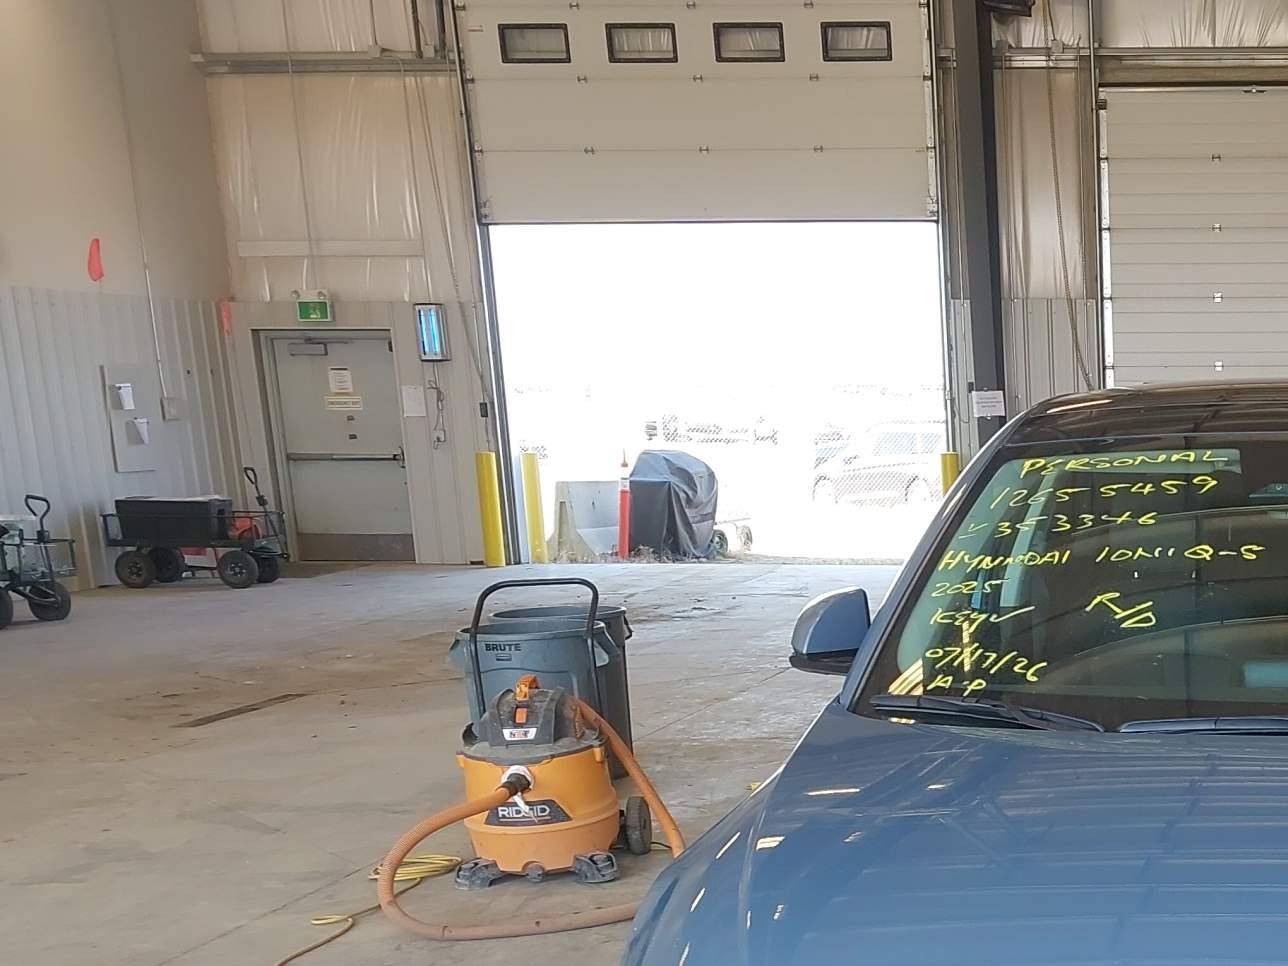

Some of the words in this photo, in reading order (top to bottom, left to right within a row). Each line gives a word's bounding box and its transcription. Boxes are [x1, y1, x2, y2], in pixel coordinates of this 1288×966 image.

[1020, 451, 1228, 479] PERSONAL
[931, 579, 1009, 597] 2025
[485, 643, 522, 652] BRUTE
[925, 643, 1048, 682] 07/17/26
